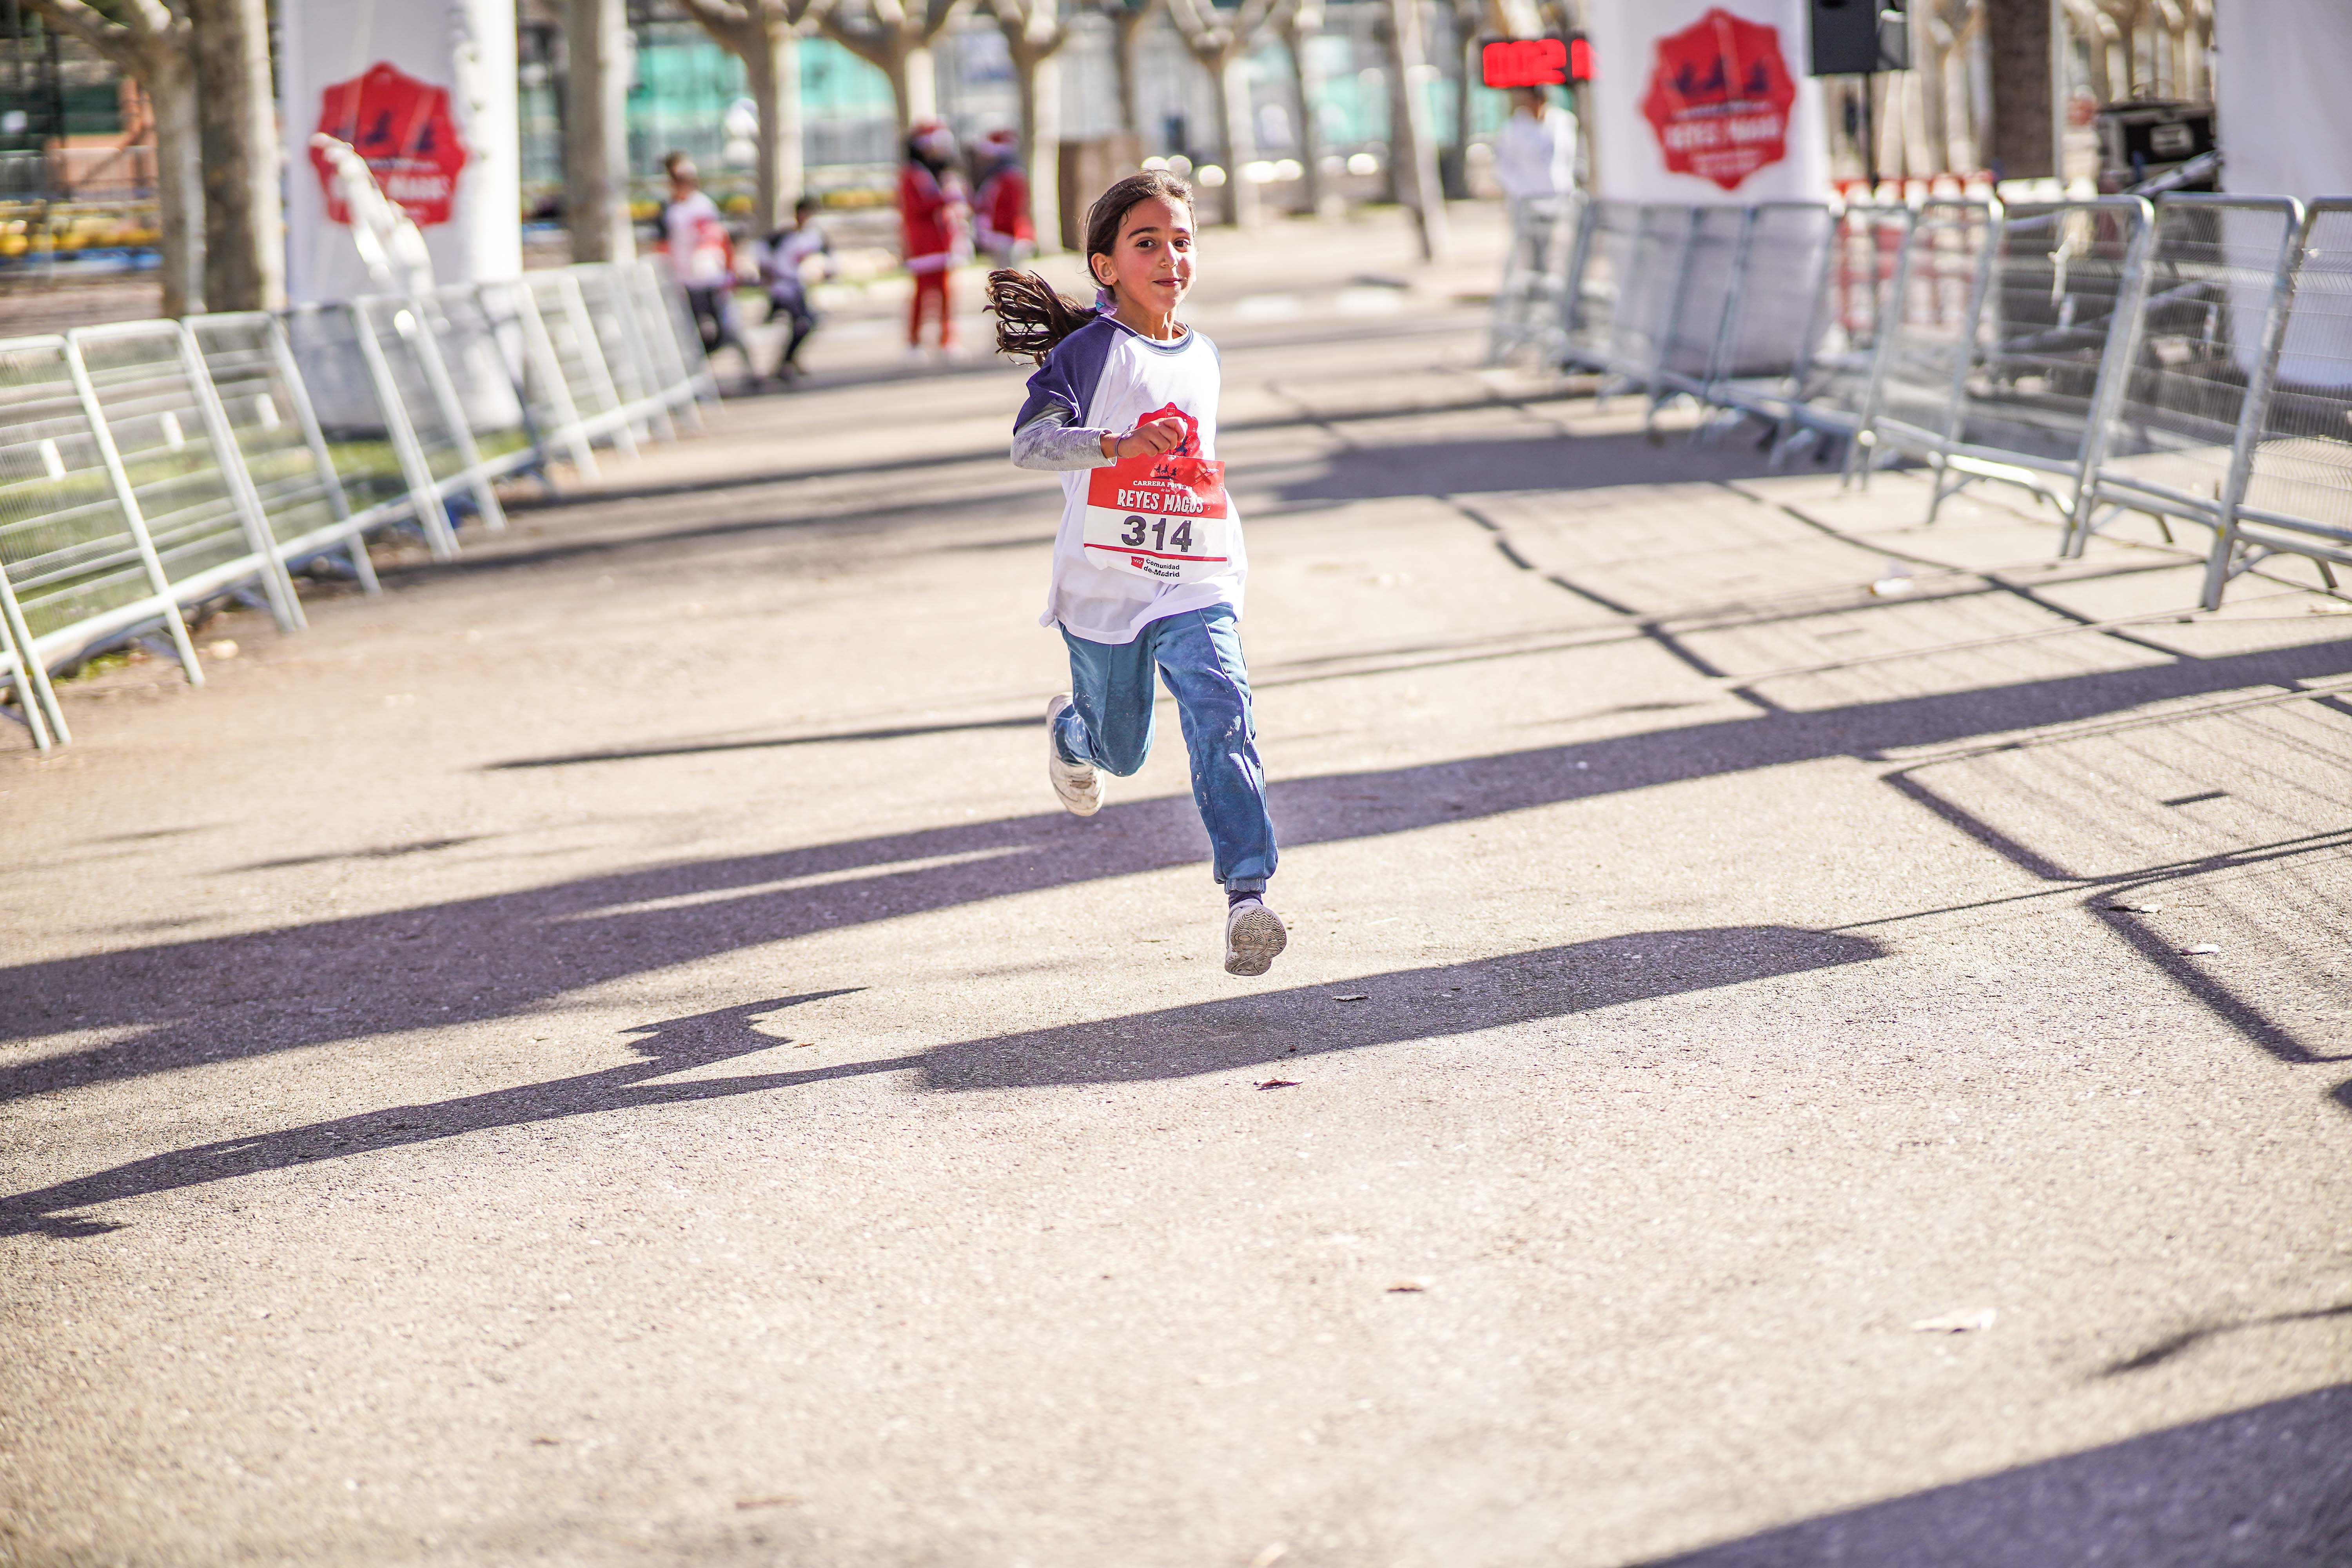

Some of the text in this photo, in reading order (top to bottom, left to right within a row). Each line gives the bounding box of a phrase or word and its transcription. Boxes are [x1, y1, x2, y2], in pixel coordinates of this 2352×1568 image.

[1117, 489, 1204, 513] REYES MAGOS
[1122, 515, 1192, 552] 314
[1146, 559, 1180, 570] Comunidad
